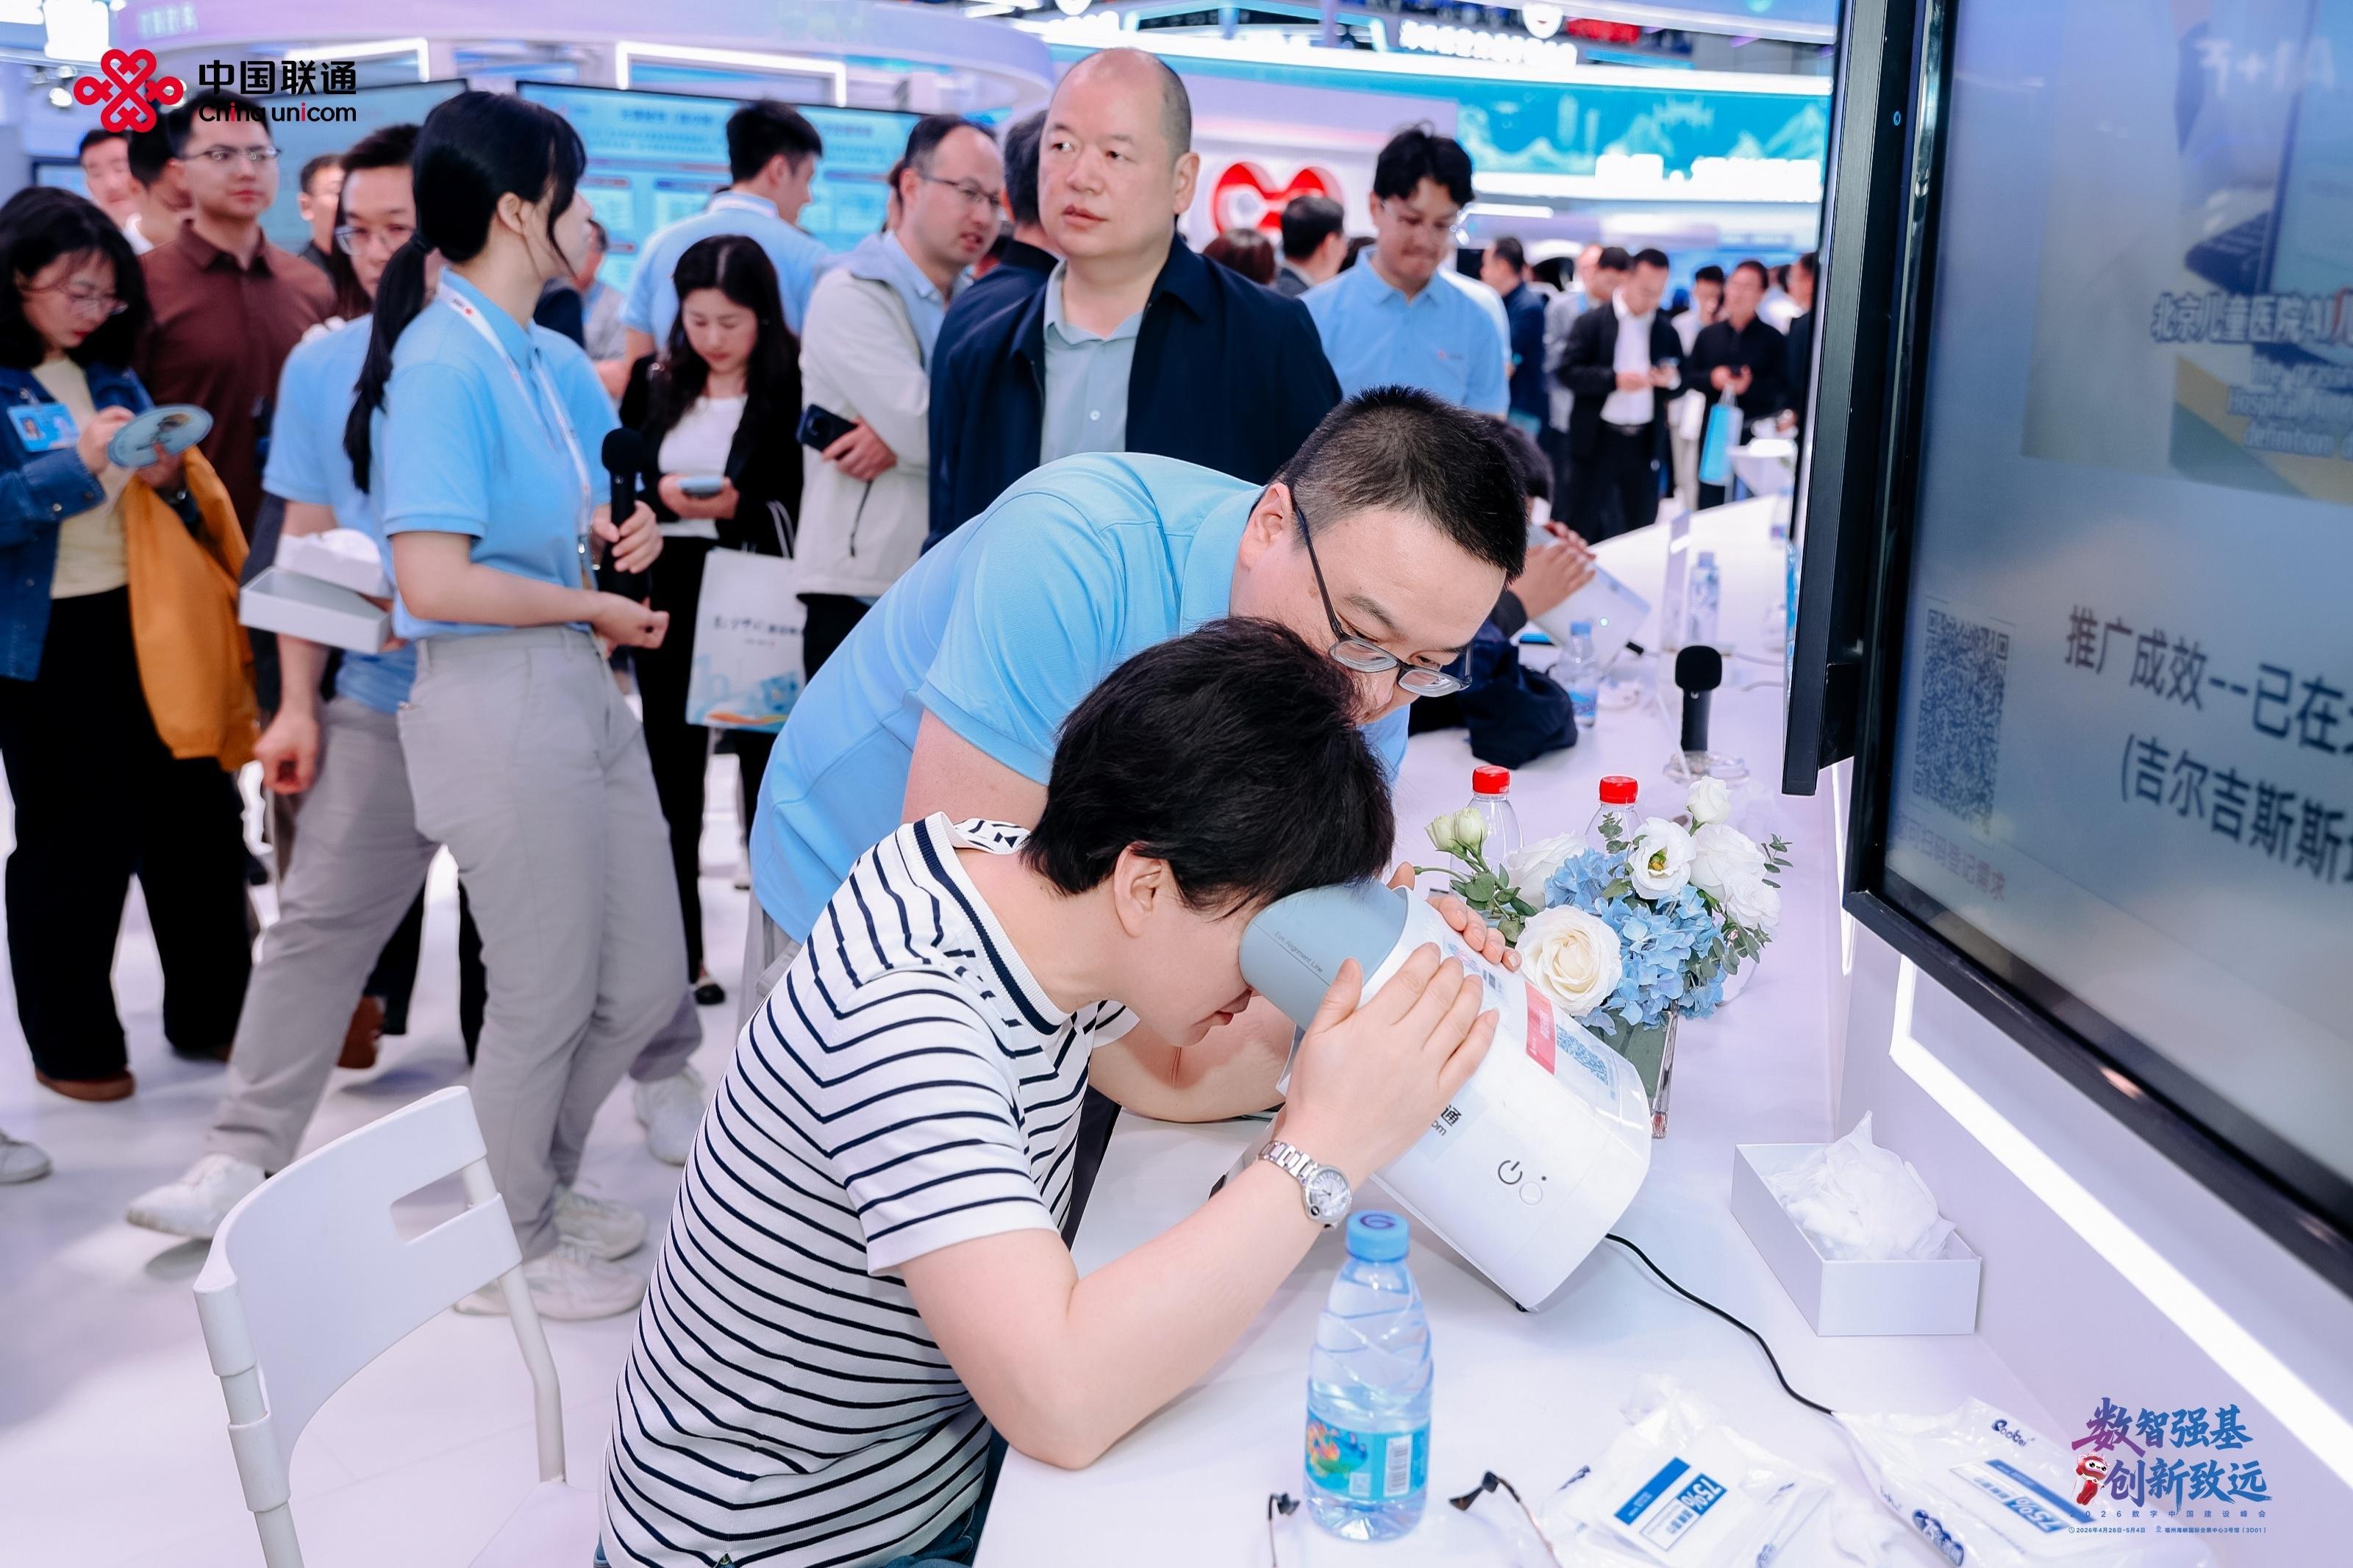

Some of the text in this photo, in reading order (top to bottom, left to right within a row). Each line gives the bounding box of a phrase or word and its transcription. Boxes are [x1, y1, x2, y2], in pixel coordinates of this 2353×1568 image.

[2064, 604, 2353, 756] 推广成效--已在
[2122, 733, 2353, 887] (吉尔吉斯斯
[1440, 1104, 1462, 1127] 通
[1679, 1477, 1723, 1511] 75%
